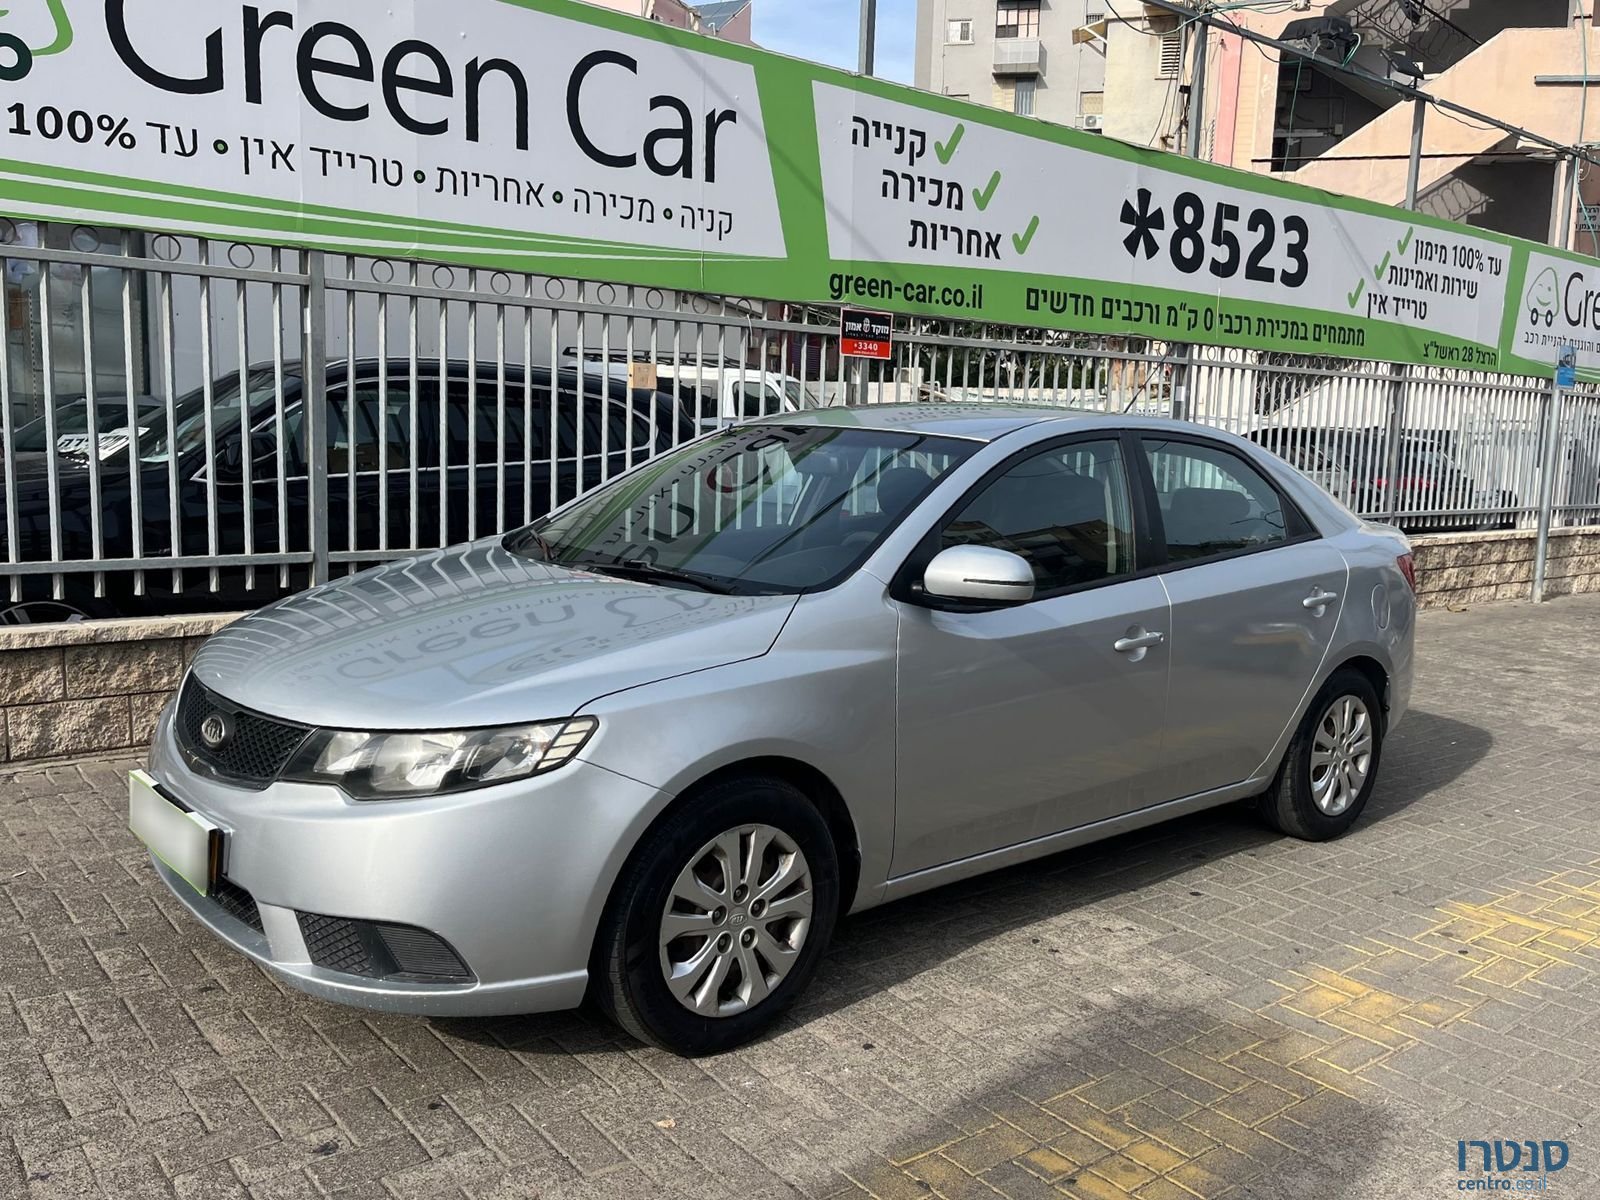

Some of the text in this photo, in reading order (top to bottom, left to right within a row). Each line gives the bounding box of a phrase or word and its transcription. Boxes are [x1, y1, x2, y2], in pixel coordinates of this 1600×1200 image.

[103, 0, 737, 184] Green Car
[851, 115, 926, 167] קנייה
[7, 102, 734, 241] קניה מכירה אחריות טרייד אין עד 100%
[881, 168, 964, 211] מכירה
[908, 218, 1002, 260] אחריות
[1414, 239, 1502, 277] עד 100% מימון
[829, 273, 983, 310] green-car.co.il
[1387, 264, 1478, 300] שירות ואמינות
[1026, 287, 1094, 317] חדשים
[1101, 297, 1160, 326] ורכבים
[1367, 292, 1428, 321] טרייד אין
[1203, 306, 1214, 332] 0
[1218, 312, 1252, 337] רכבי
[1255, 316, 1309, 342] במכירת
[1312, 323, 1366, 347] מתמחים
[1524, 331, 1539, 344] רכב
[1461, 346, 1474, 362] 28
[1475, 347, 1497, 366] הרצל
